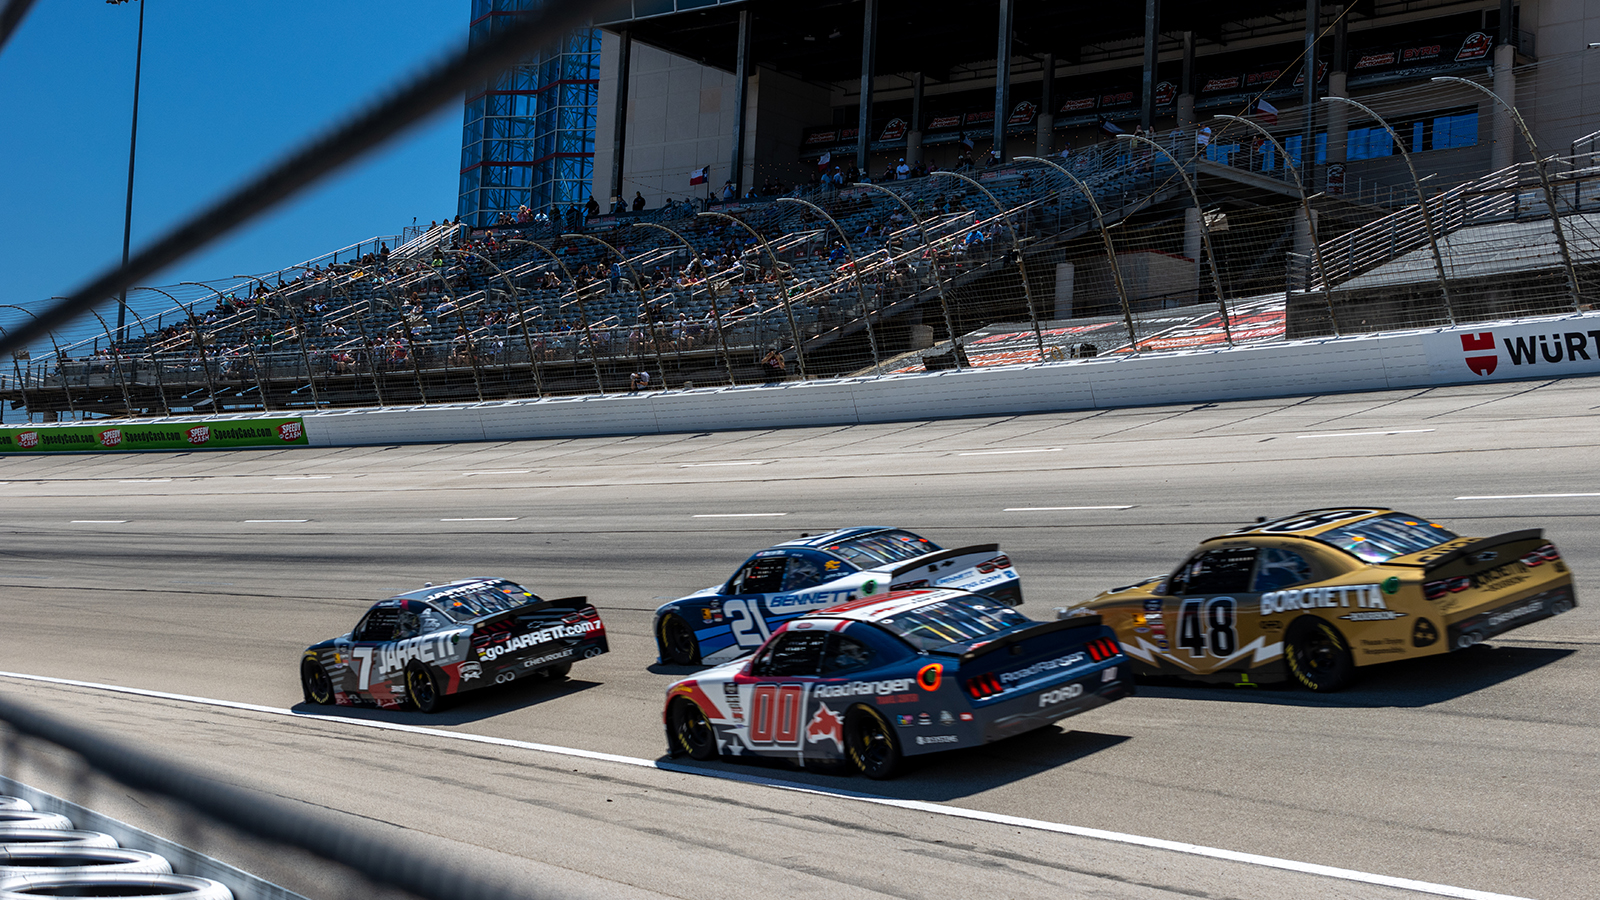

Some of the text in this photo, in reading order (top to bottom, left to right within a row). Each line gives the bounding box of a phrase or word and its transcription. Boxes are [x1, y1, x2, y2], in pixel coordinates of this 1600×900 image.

[1403, 45, 1441, 58] BYRD
[1247, 70, 1280, 83] BYRD
[1102, 92, 1133, 104] BYRD
[103, 429, 121, 440] SPEEDY
[190, 426, 209, 437] SPEEDY
[214, 427, 272, 440] SpeedyCash.com
[281, 422, 302, 434] SPEEDY
[20, 431, 38, 441] SPEEDY
[42, 433, 95, 445] SpeedyCash.com
[105, 437, 122, 446] CASH
[125, 430, 181, 444] SpeedyCash.com
[192, 434, 210, 443] CASH
[284, 431, 302, 440] CASH
[23, 439, 38, 447] CASH
[770, 588, 857, 607] BENNETT
[1260, 583, 1388, 616] BORCHETTA
[723, 599, 772, 647] 21
[1175, 596, 1239, 658] 48
[485, 620, 601, 661] goJARRETT.com 7
[378, 627, 469, 675] JARRETT
[523, 648, 575, 668] CHEVROLET
[353, 646, 375, 691] 7
[813, 678, 916, 698] RoadRanger
[1038, 682, 1084, 707] FORD
[750, 683, 804, 743] 00
